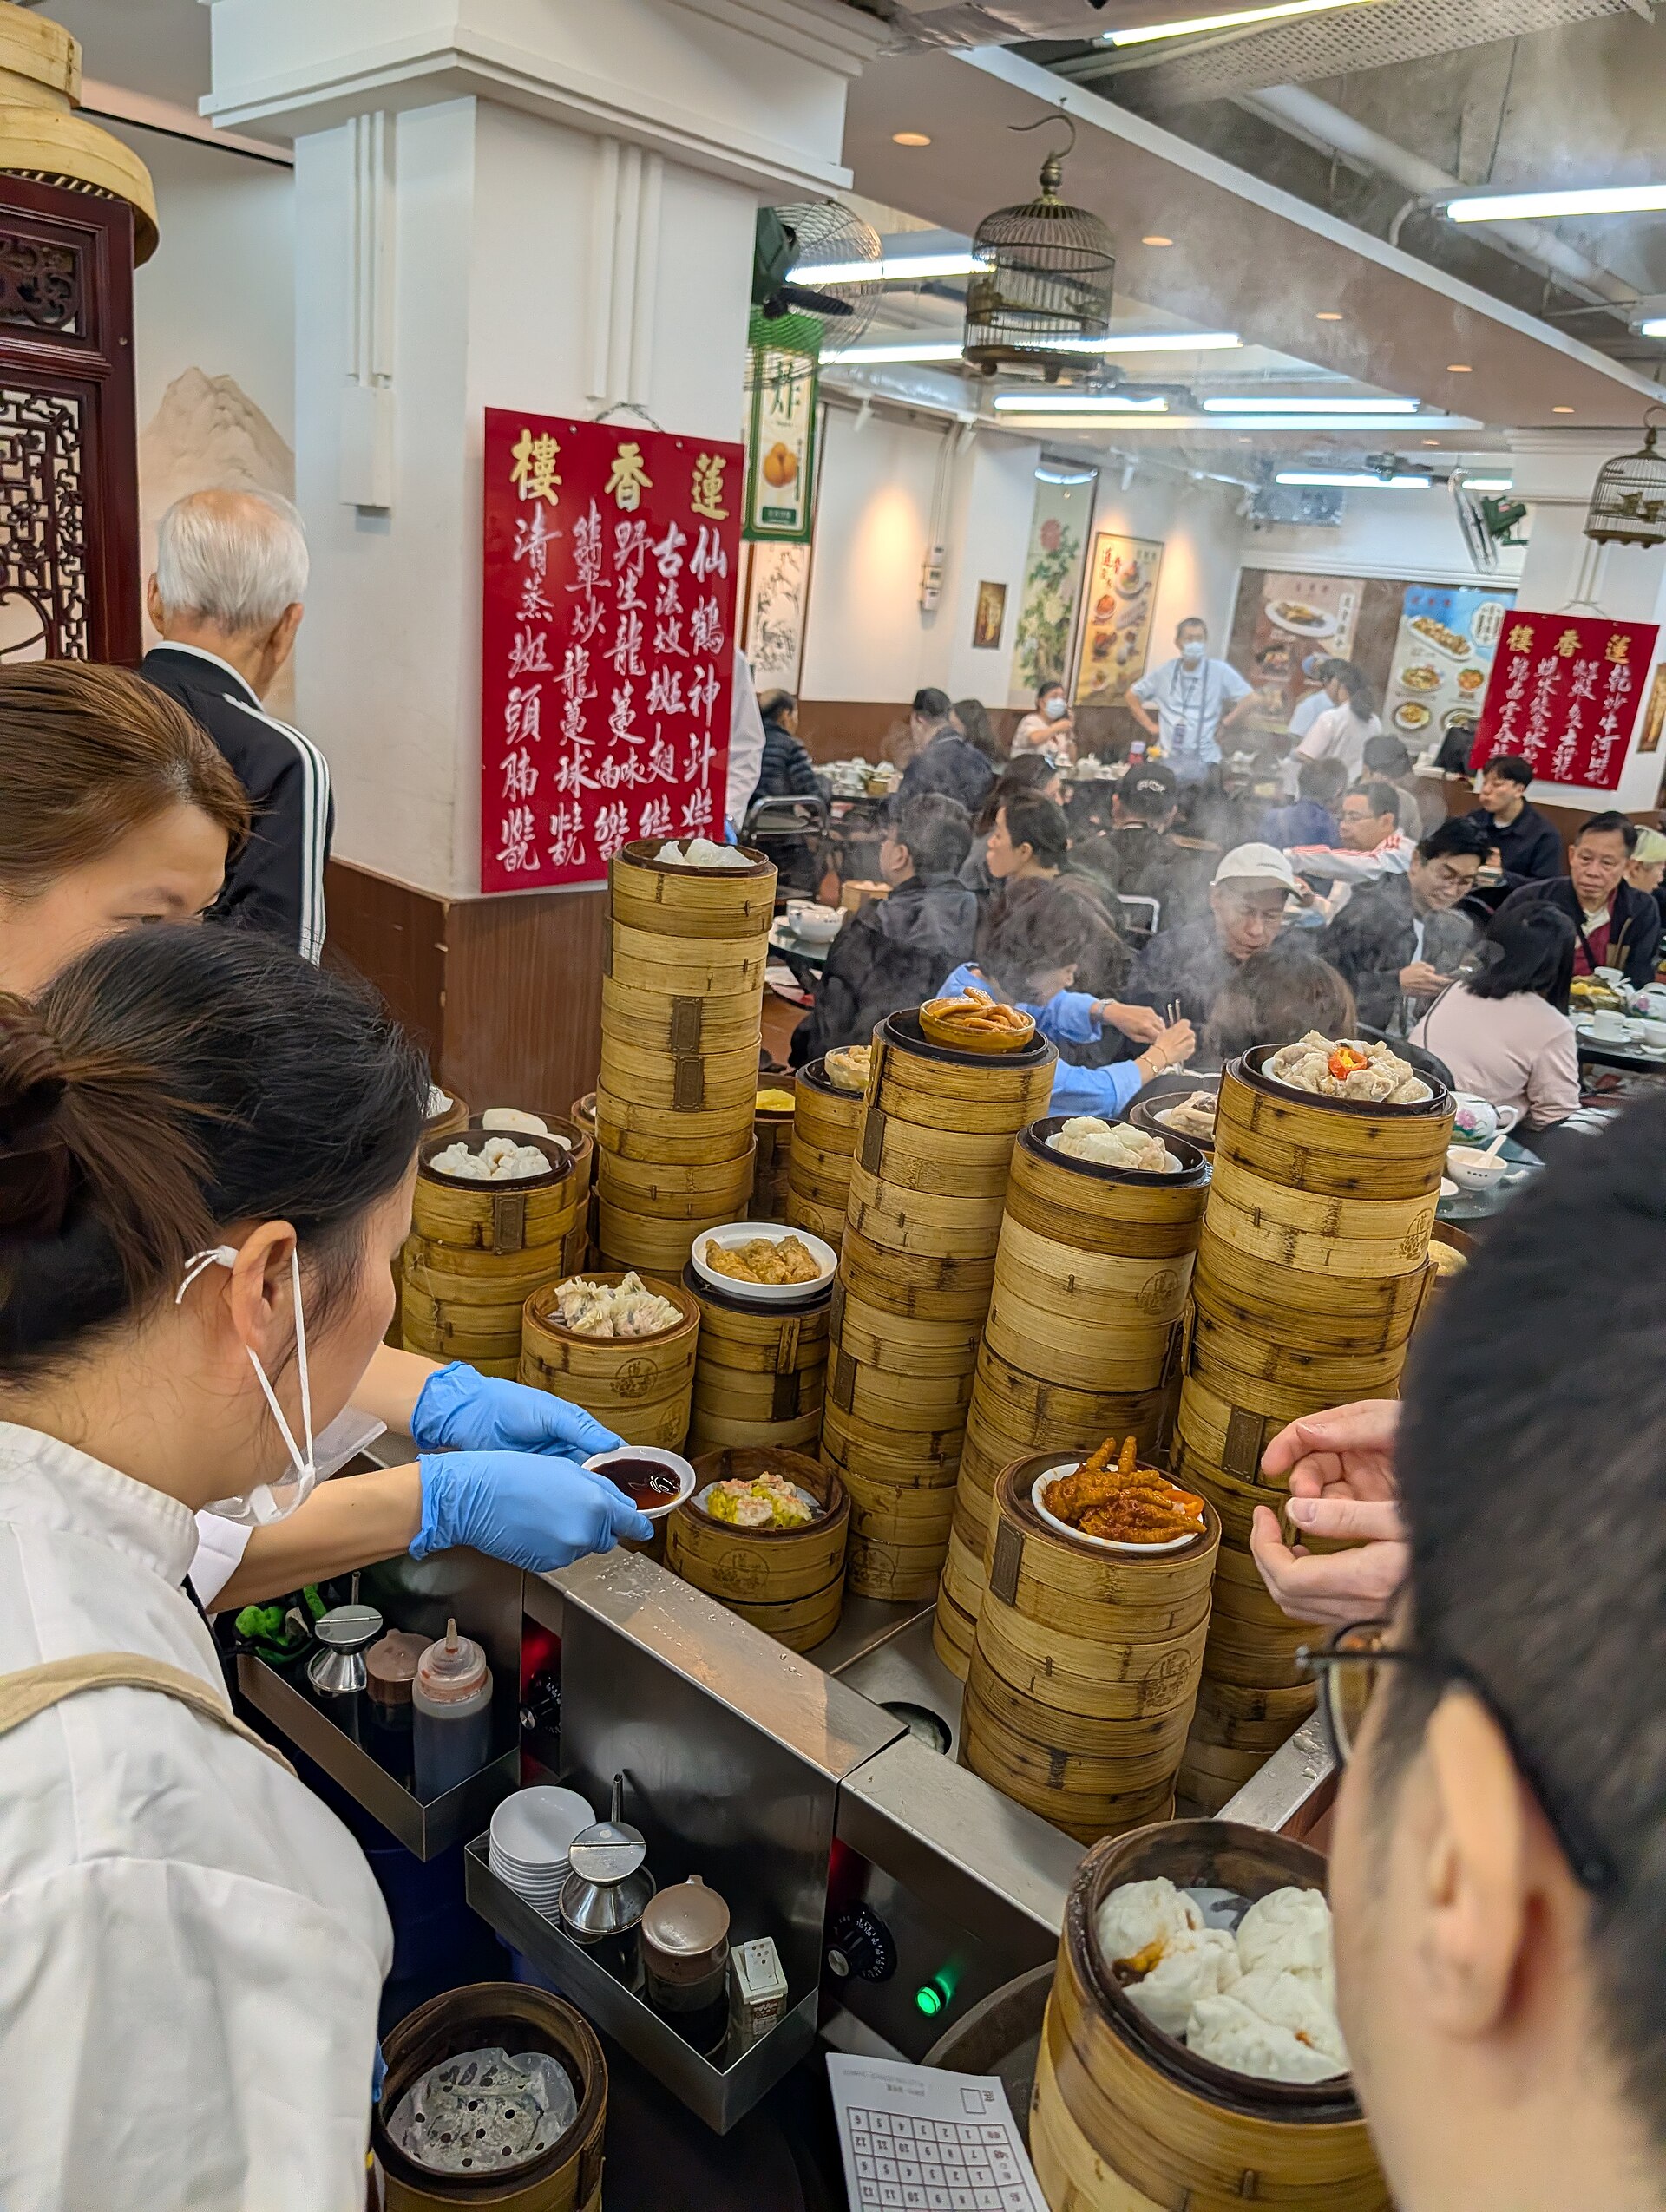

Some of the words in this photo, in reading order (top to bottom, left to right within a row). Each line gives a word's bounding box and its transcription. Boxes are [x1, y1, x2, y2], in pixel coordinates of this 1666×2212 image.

[899, 2122, 904, 2131] 4
[921, 2125, 927, 2136] 3
[942, 2128, 949, 2137] 2
[964, 2130, 971, 2140] 1
[924, 2146, 931, 2156] 9
[948, 2148, 954, 2158] 8
[971, 2150, 977, 2159] 7
[906, 2168, 912, 2177] 4
[929, 2169, 935, 2179] 3
[953, 2170, 960, 2181] 2
[977, 2171, 984, 2181] 1
[935, 2194, 941, 2203] 9
[984, 2195, 991, 2204] 7
